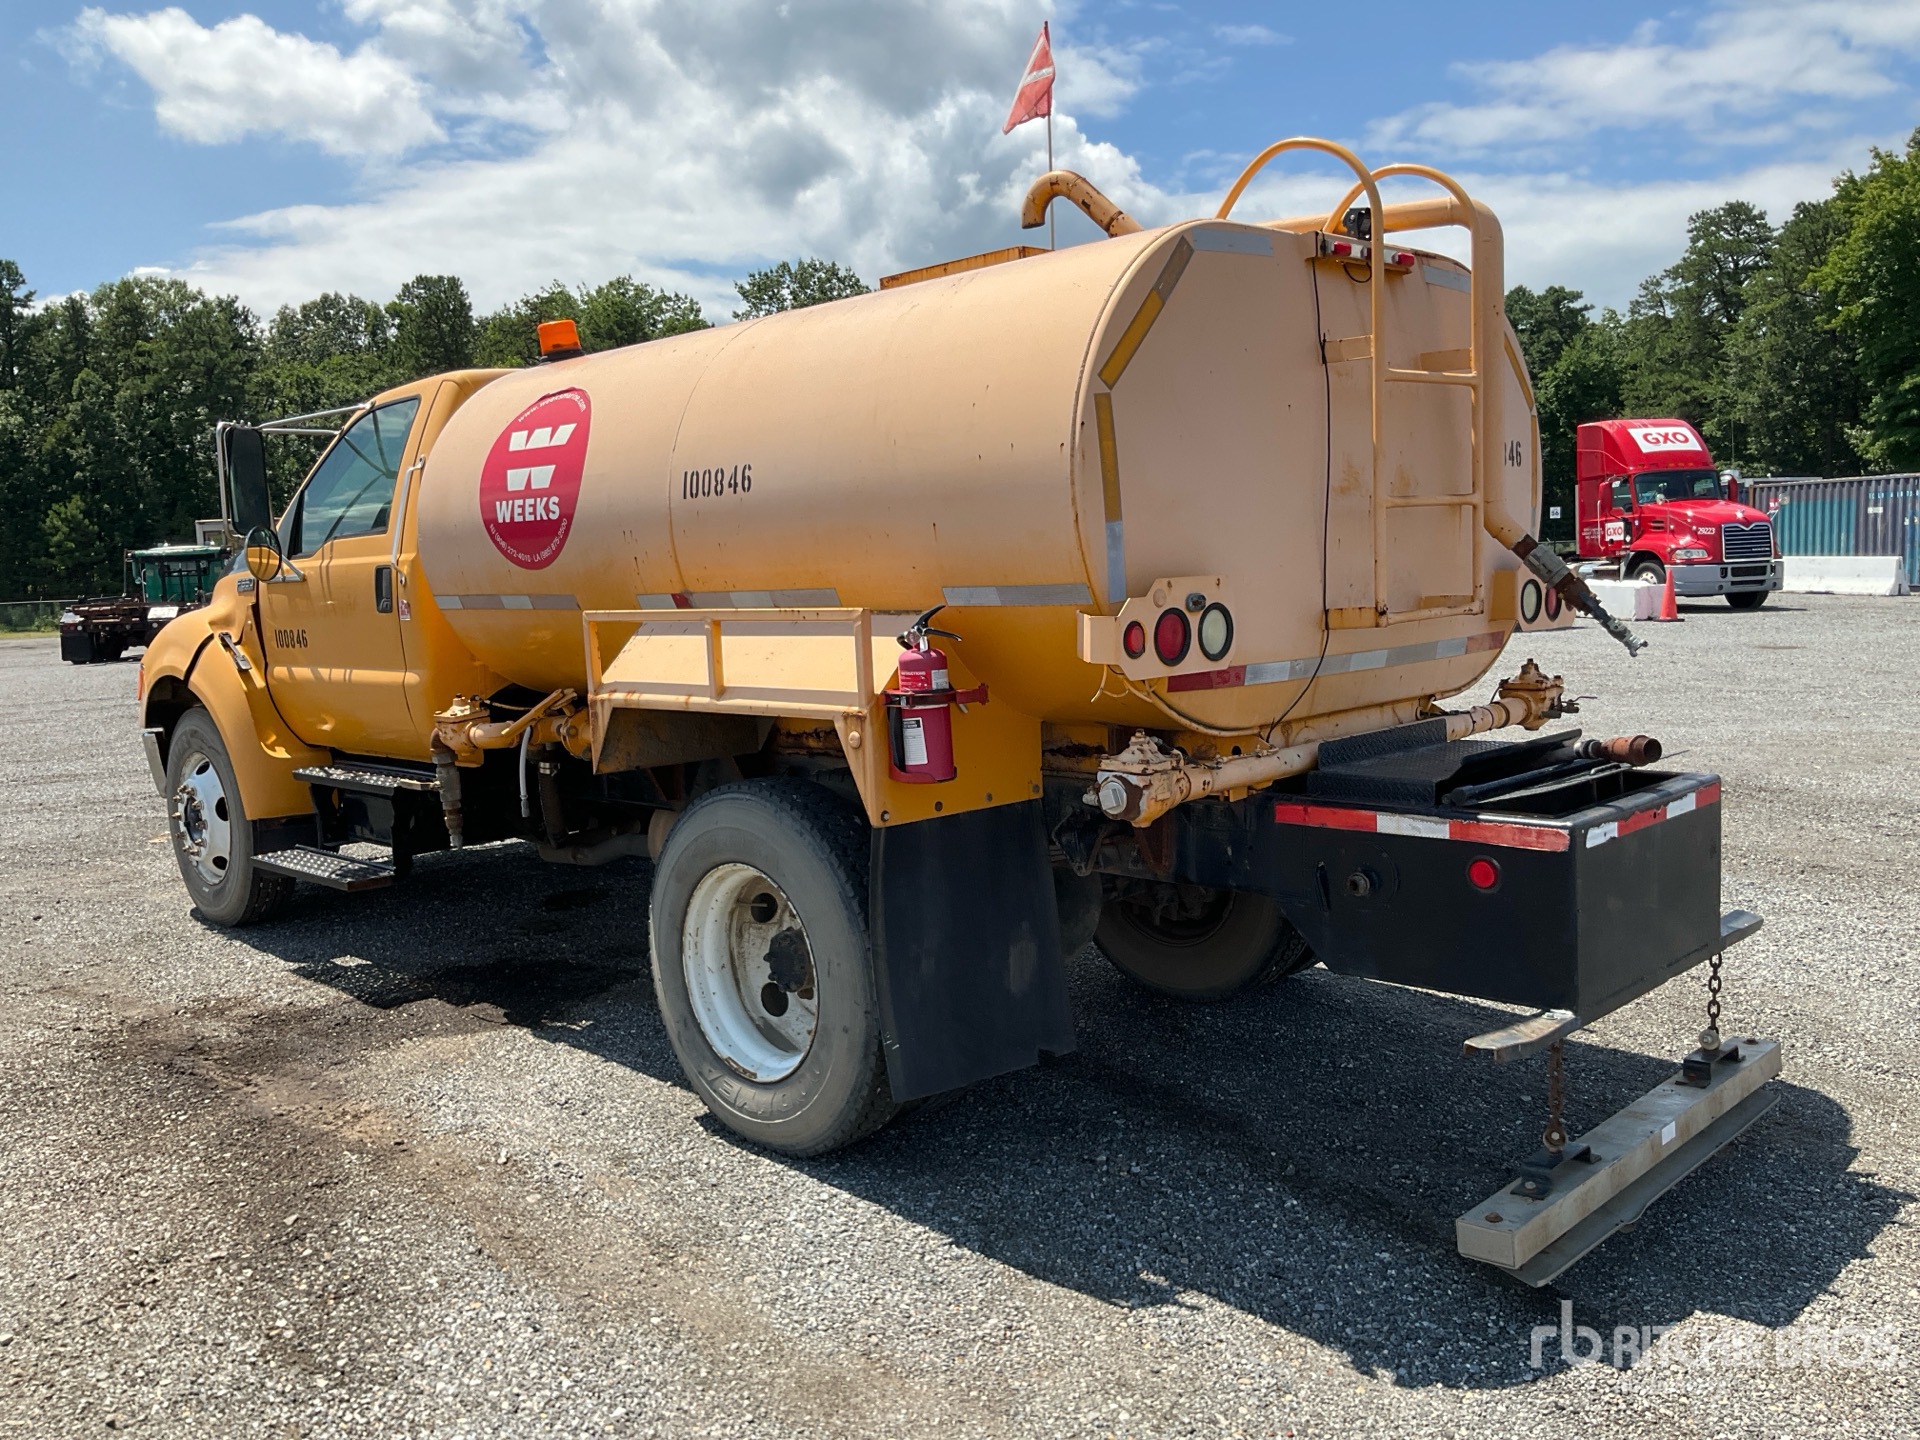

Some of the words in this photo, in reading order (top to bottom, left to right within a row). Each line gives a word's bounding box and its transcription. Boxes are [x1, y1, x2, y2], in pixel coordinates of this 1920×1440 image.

[1642, 432, 1690, 446] GXO
[1504, 440, 1522, 468] 46
[682, 463, 753, 499] 100846
[495, 495, 560, 523] WEEKS
[1606, 526, 1623, 537] GXO
[274, 629, 309, 649] 100846
